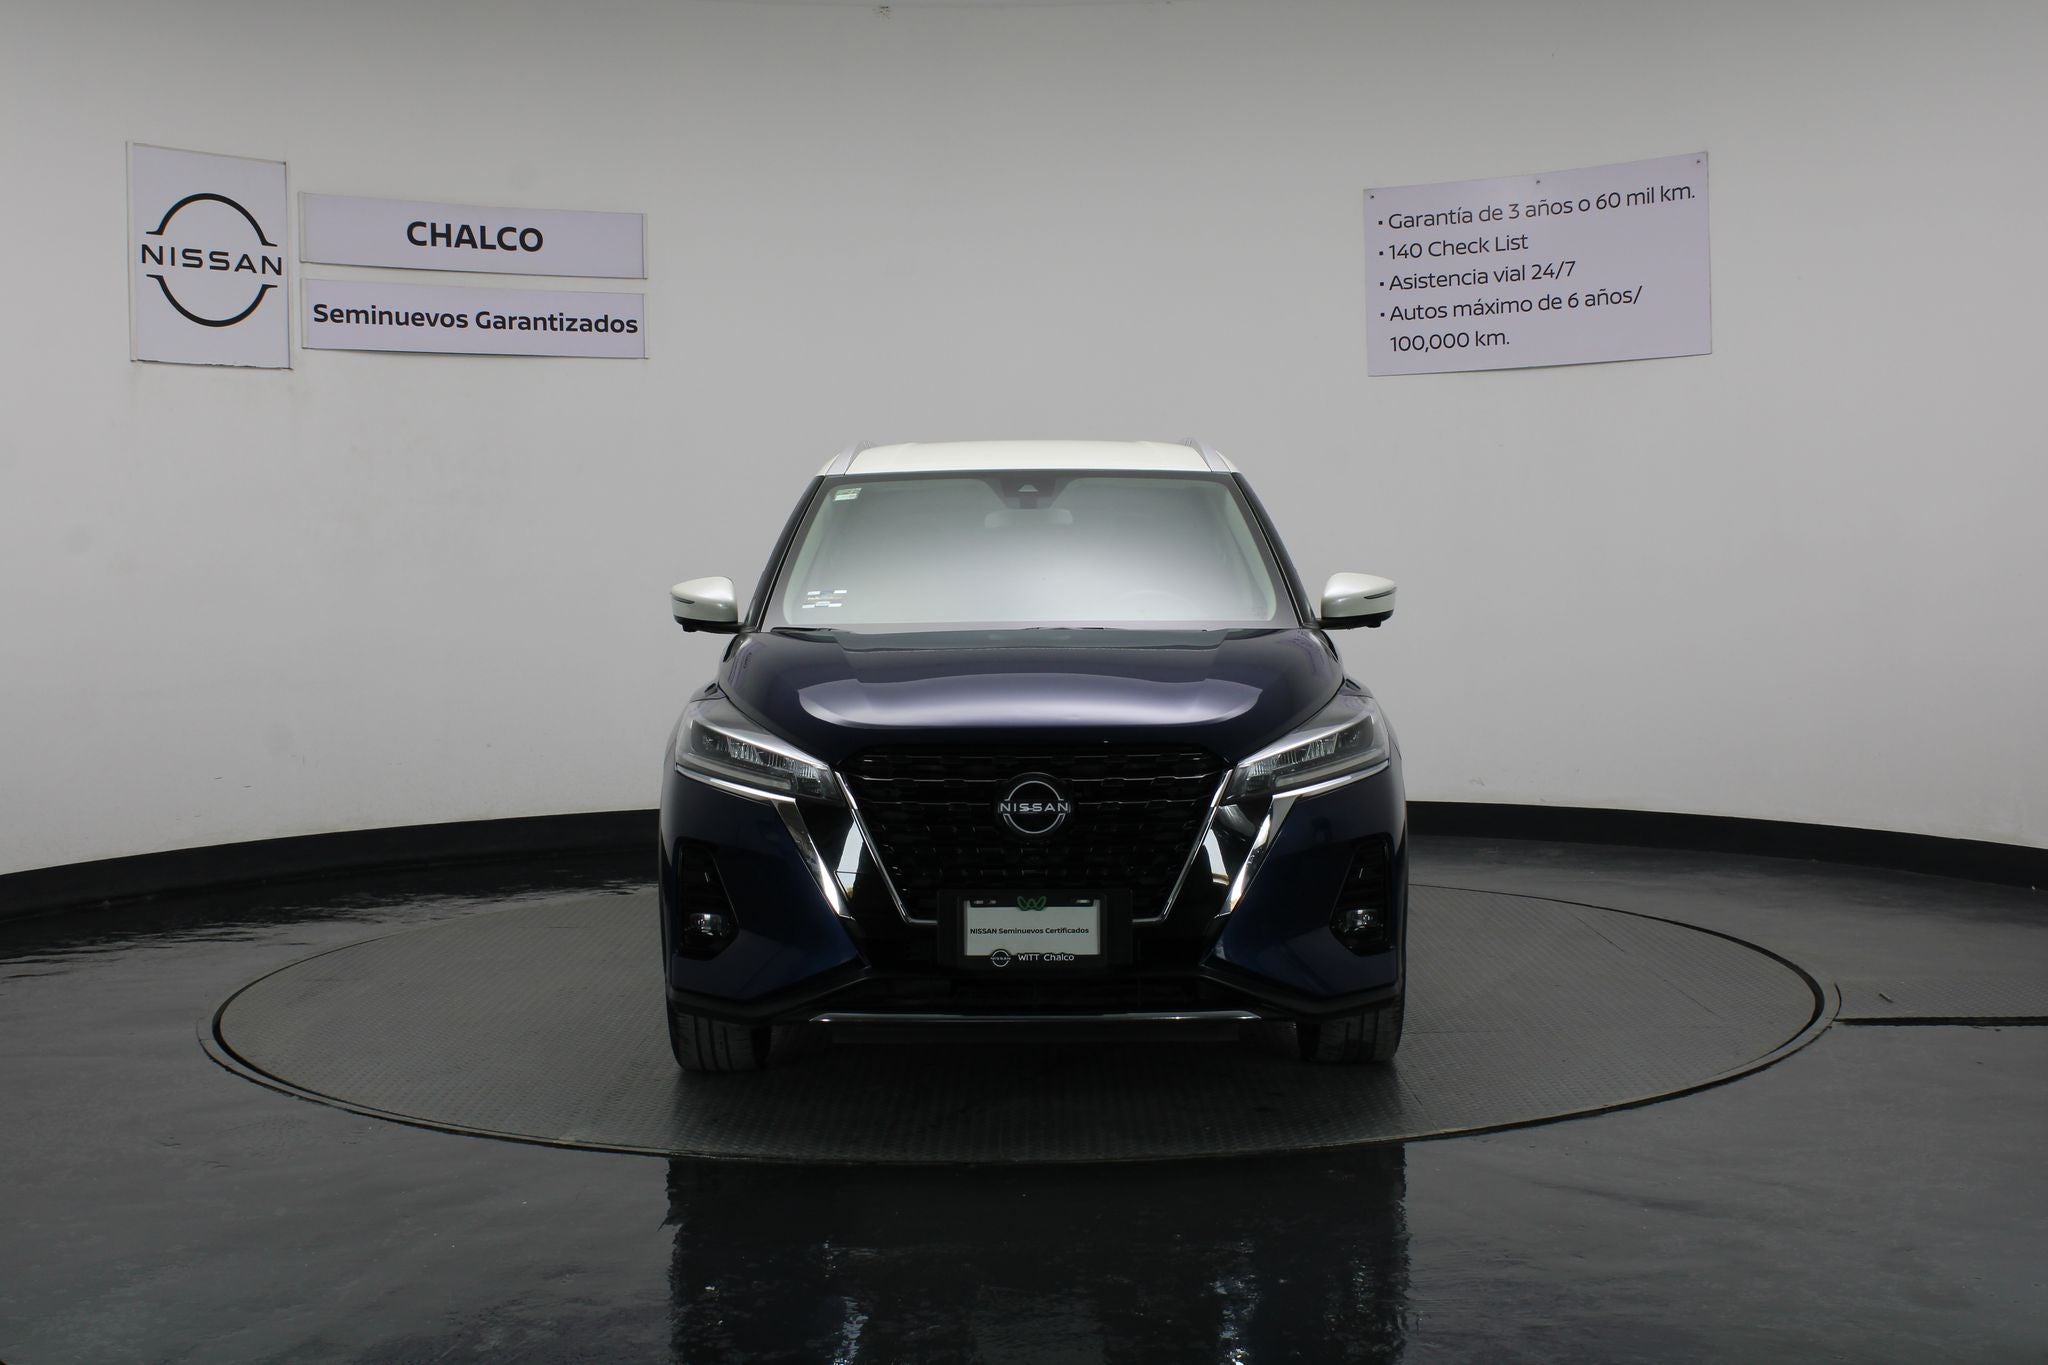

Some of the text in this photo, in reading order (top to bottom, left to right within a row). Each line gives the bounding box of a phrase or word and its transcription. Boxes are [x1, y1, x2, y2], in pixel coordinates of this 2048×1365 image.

[1388, 184, 1696, 230] Garantía de 3 años o 60 mil km.
[406, 220, 544, 253] CHALCO
[1388, 233, 1529, 260] 140 Check List
[141, 243, 282, 276] NISSAN
[1388, 260, 1576, 291] Asistencia vial 24/7
[313, 303, 639, 334] Seminuevos Garantizados
[1389, 285, 1643, 322] Autos máximo de 6 años/
[1389, 330, 1511, 353] 100,000 km.
[1000, 802, 1069, 813] NISSAN
[970, 926, 1089, 935] NISSAN Seminuevos Certificados
[1018, 952, 1075, 962] WITT Chalco
